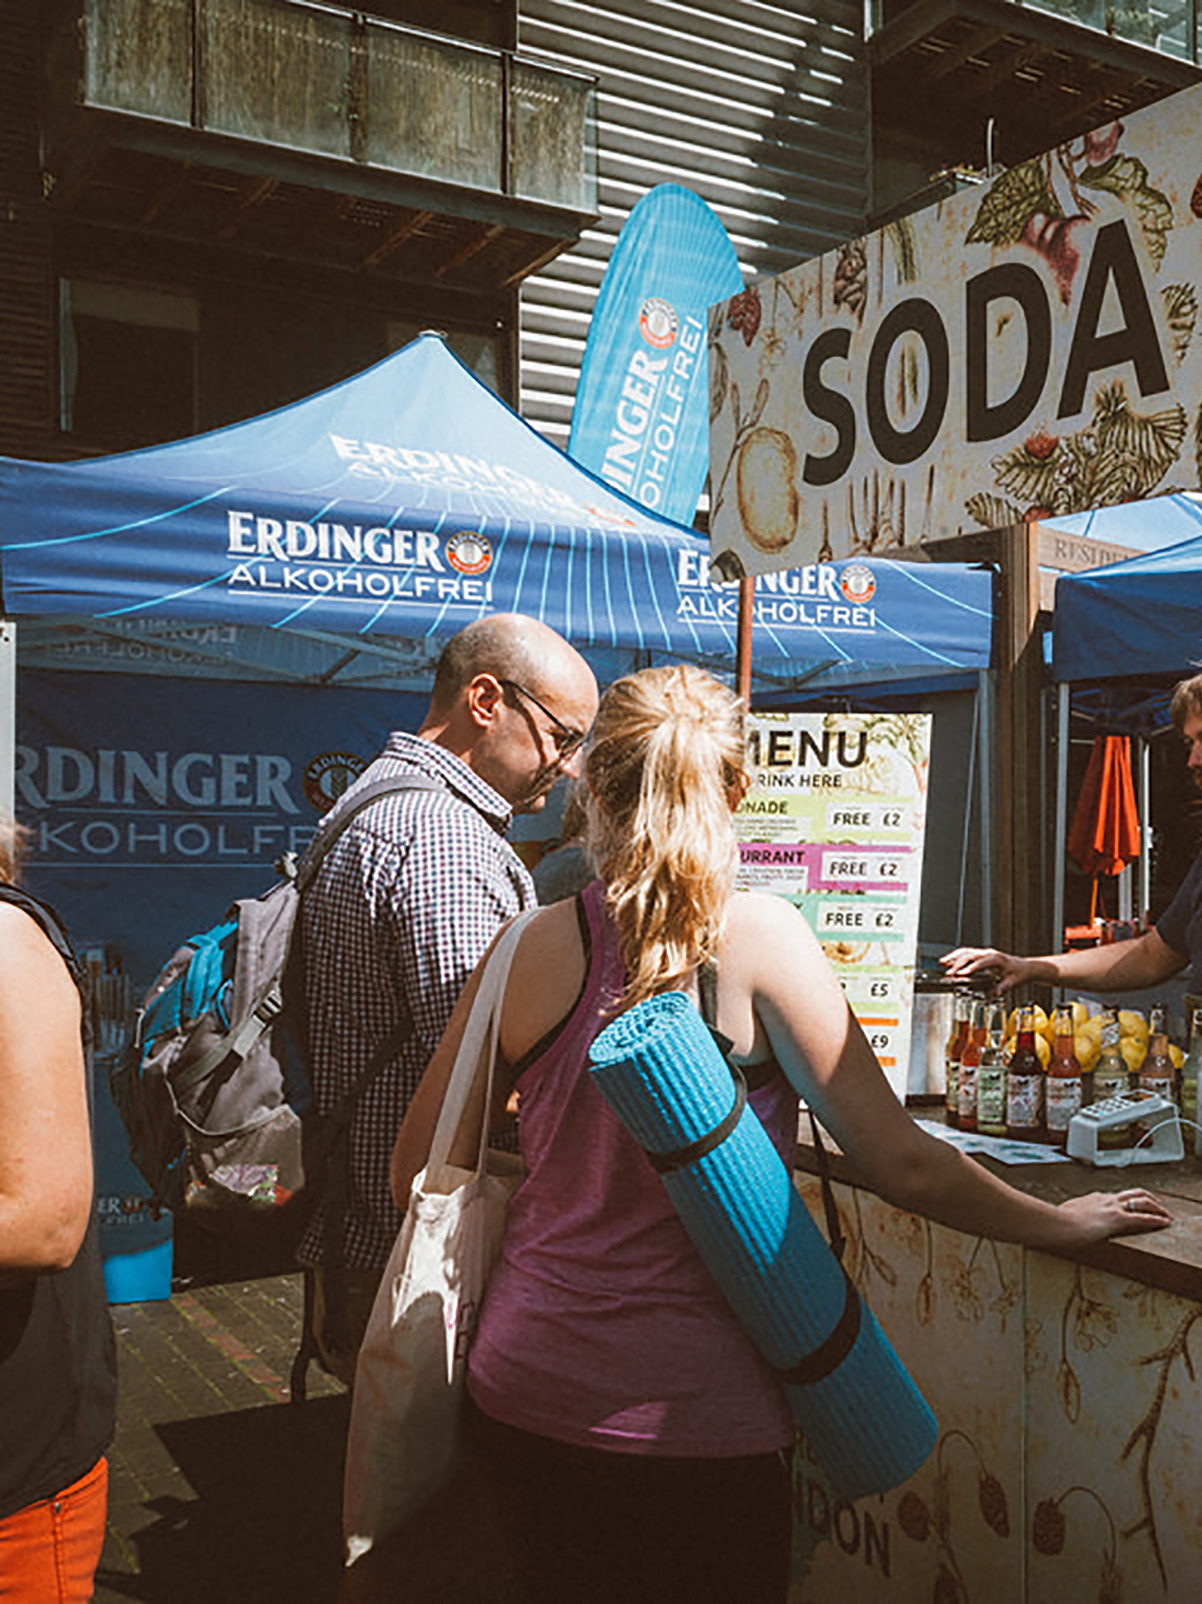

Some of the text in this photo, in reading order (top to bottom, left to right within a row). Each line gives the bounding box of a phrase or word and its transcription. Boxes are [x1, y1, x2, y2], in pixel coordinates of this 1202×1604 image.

[801, 217, 1171, 488] SODA
[227, 510, 447, 573] ERDINGER
[228, 563, 493, 602] ALKOHOLFREI
[676, 595, 876, 627] ALKHOLFREI
[799, 774, 843, 788] HERE
[832, 811, 901, 827] FREE £2
[26, 820, 317, 855] KOHOLFR
[740, 850, 806, 864] URRANT
[828, 861, 898, 877] FREE £2
[825, 912, 894, 928] FREE £2
[870, 983, 889, 998] £5
[871, 1034, 889, 1049] £9
